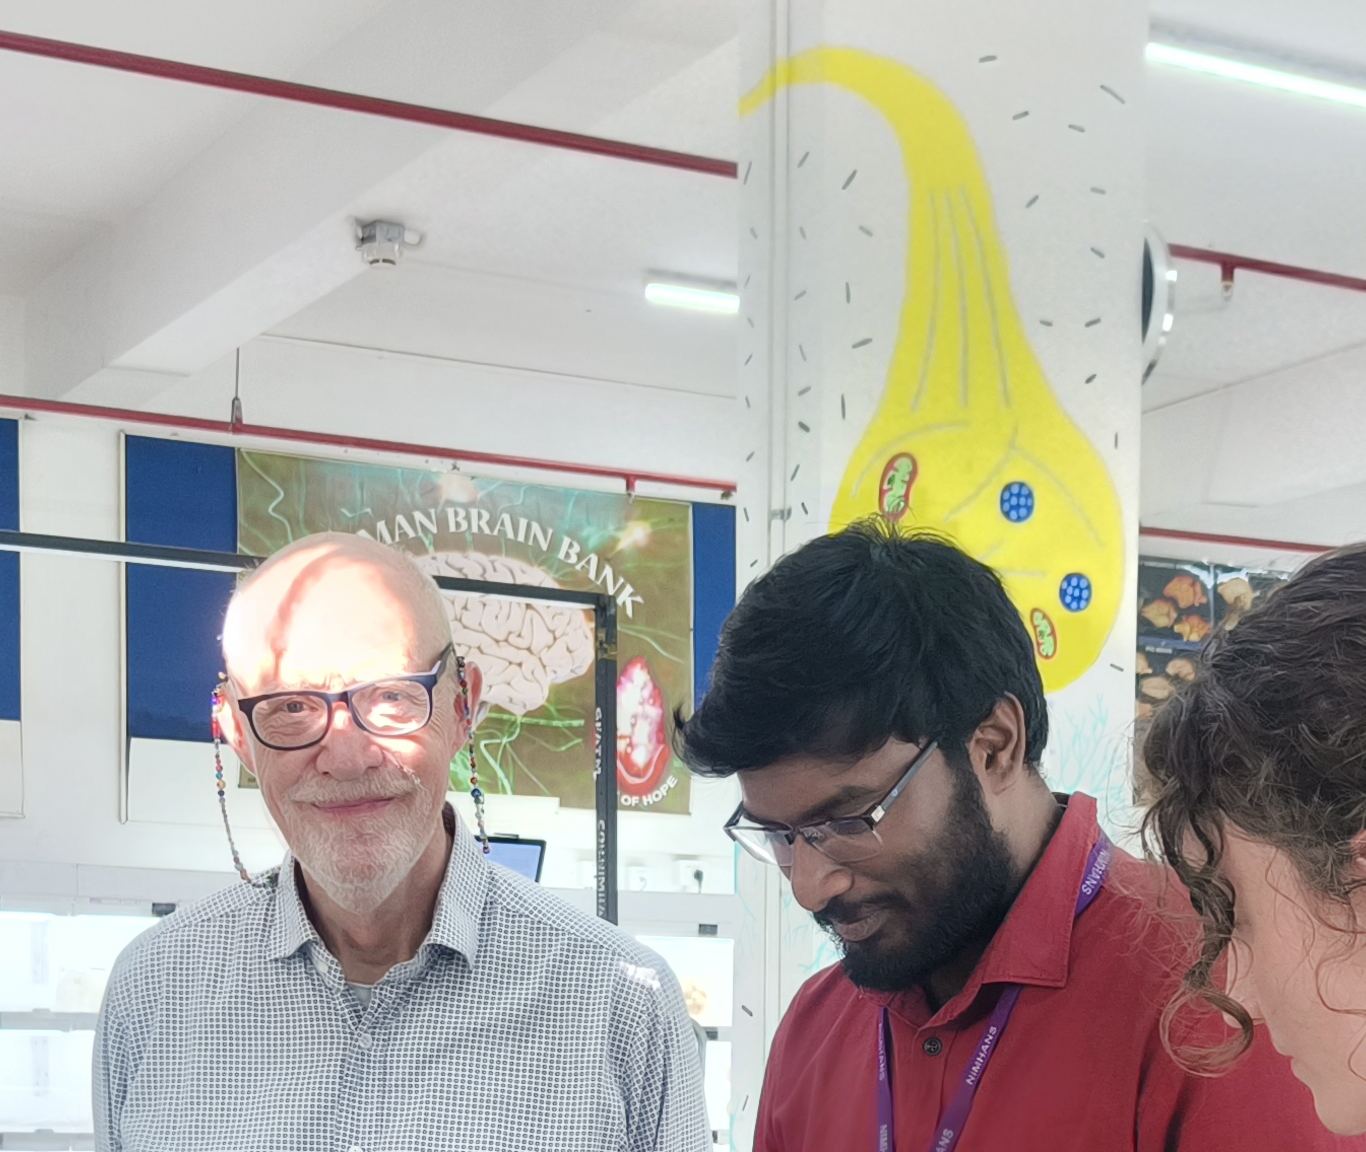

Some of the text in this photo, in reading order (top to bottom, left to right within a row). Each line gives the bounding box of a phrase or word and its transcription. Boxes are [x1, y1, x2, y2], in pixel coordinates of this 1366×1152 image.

[355, 506, 645, 619] MAN BRAIN BANK
[620, 774, 678, 807] OF HOPE
[965, 1025, 998, 1086] NIMHANS
